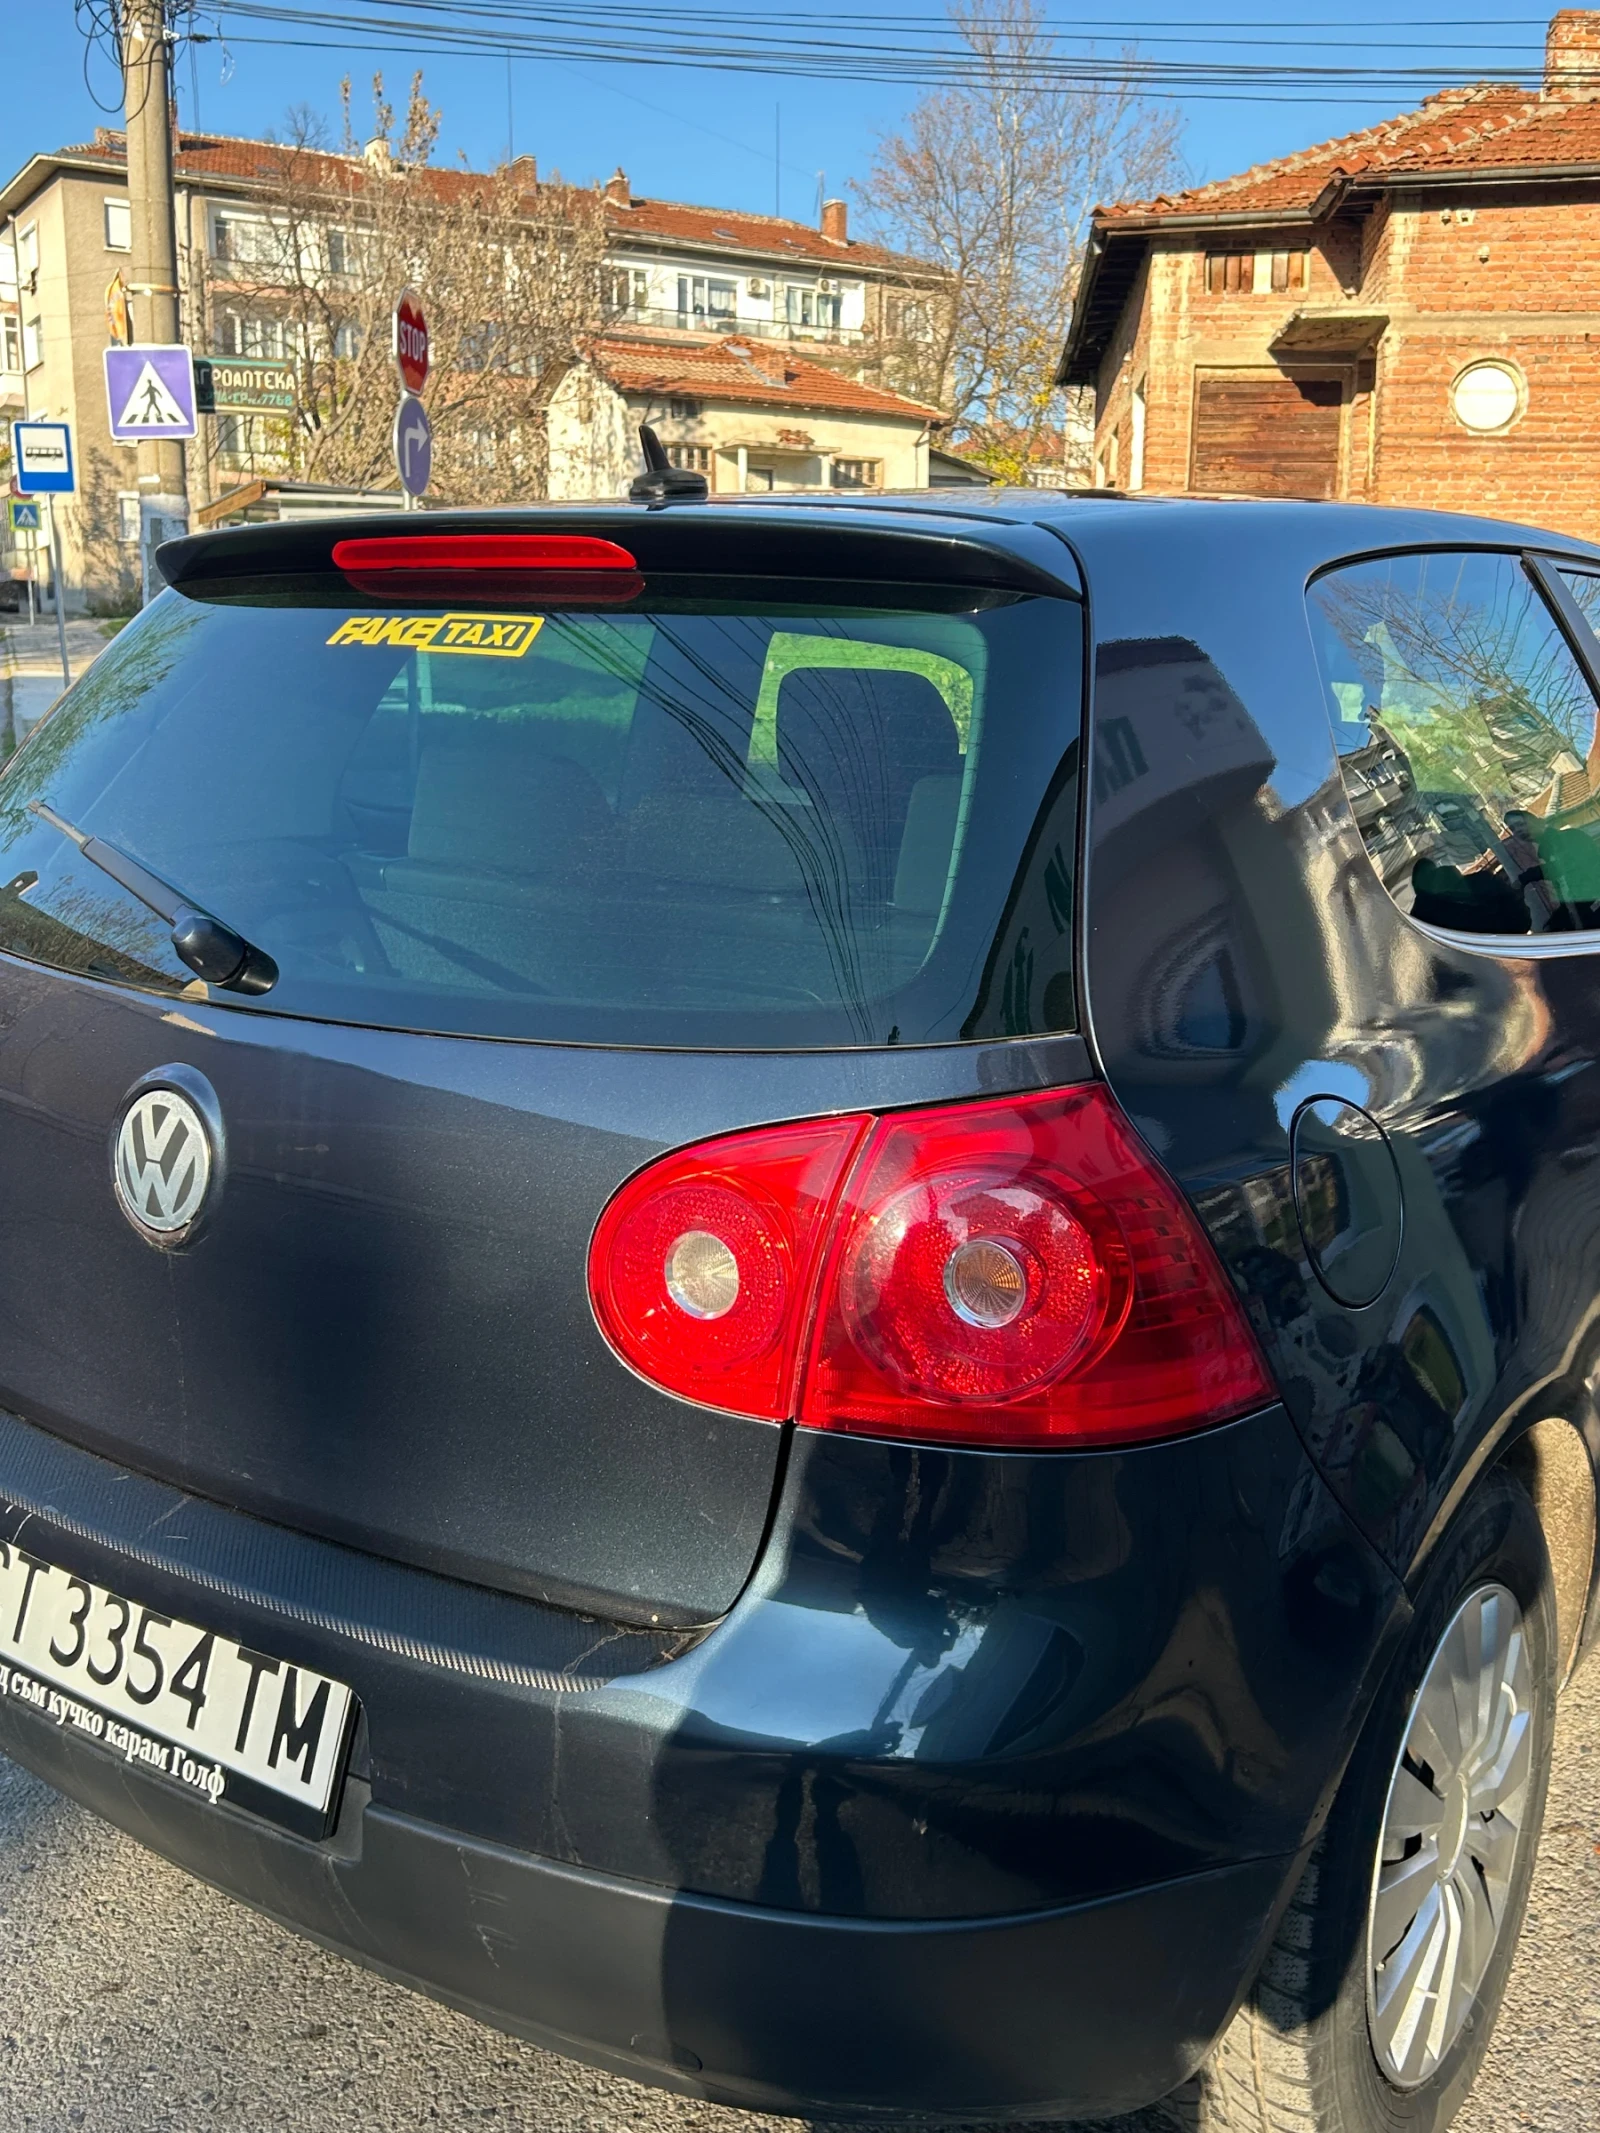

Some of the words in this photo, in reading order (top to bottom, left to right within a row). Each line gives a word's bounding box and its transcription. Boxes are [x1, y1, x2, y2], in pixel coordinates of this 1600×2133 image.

[400, 320, 426, 363] STOP
[325, 617, 446, 646] FAKE
[443, 622, 526, 647] TAXI
[49, 1576, 215, 1732] 3354
[235, 1645, 331, 1785] TM
[11, 1671, 48, 1708] съм
[47, 1690, 104, 1737] кучко
[104, 1720, 170, 1771] карам
[169, 1746, 226, 1804] Голф
